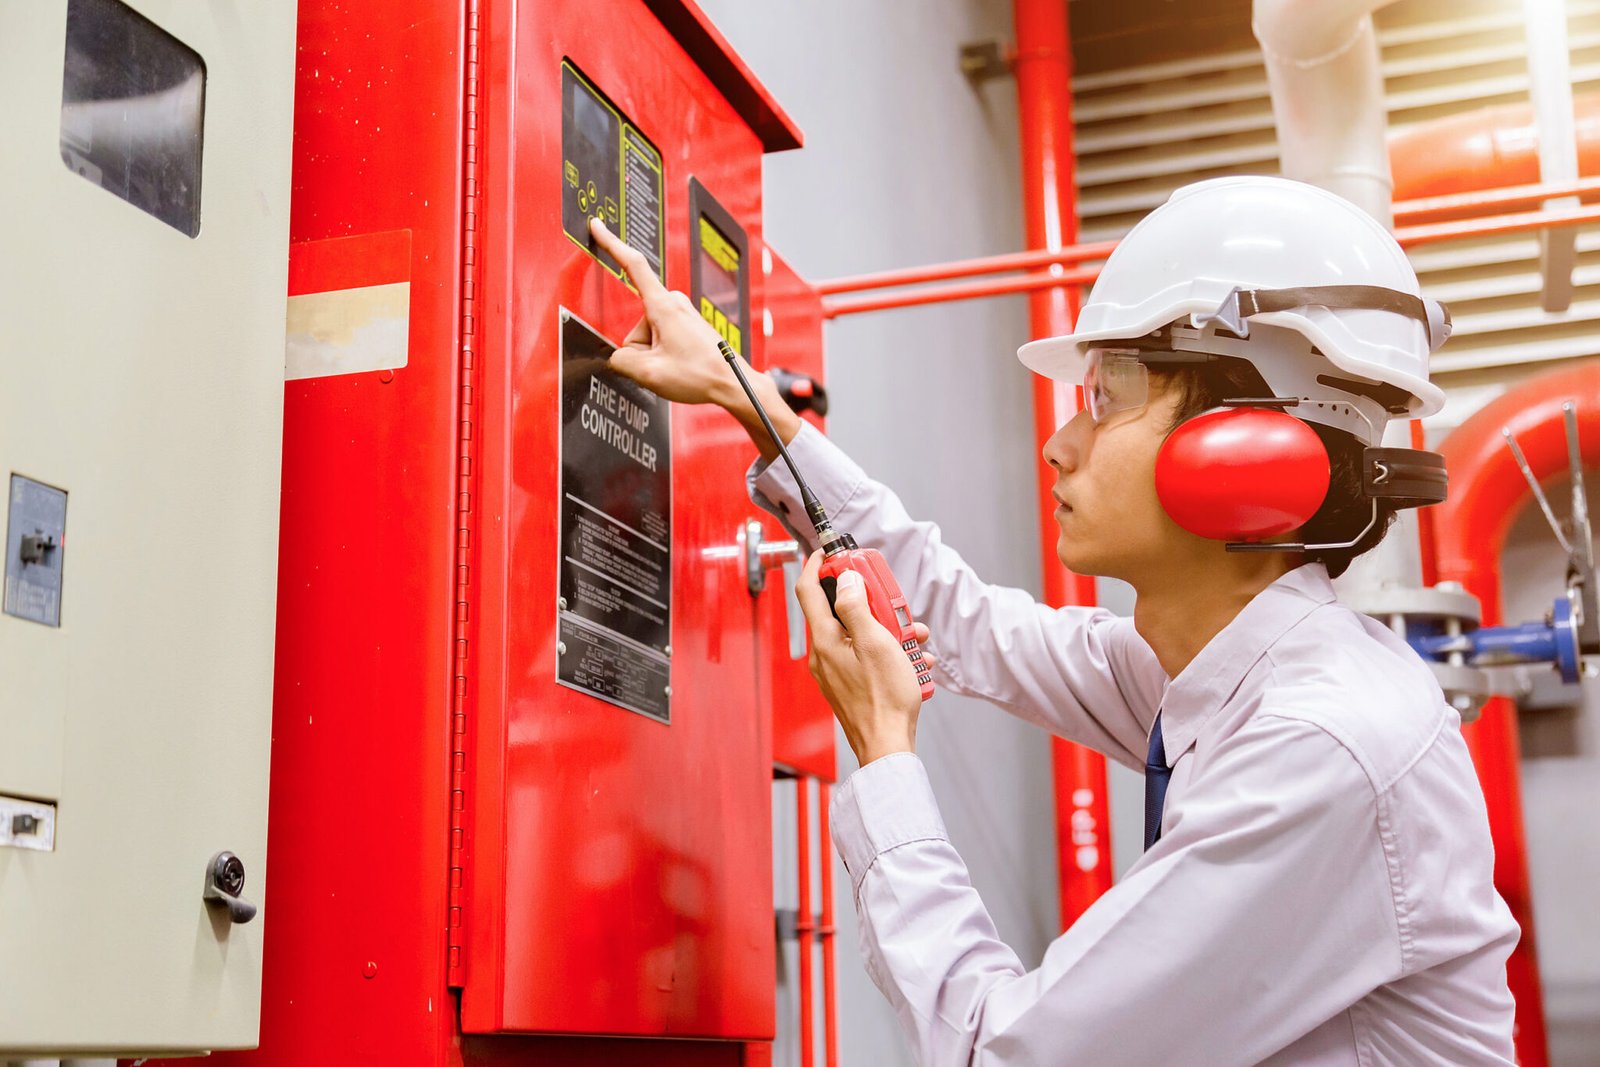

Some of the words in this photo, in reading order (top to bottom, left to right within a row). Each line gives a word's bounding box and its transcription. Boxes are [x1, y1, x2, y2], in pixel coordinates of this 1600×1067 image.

[589, 374, 616, 415] FIRE
[618, 395, 649, 434] PUMP
[581, 403, 657, 473] CONTROLLER
